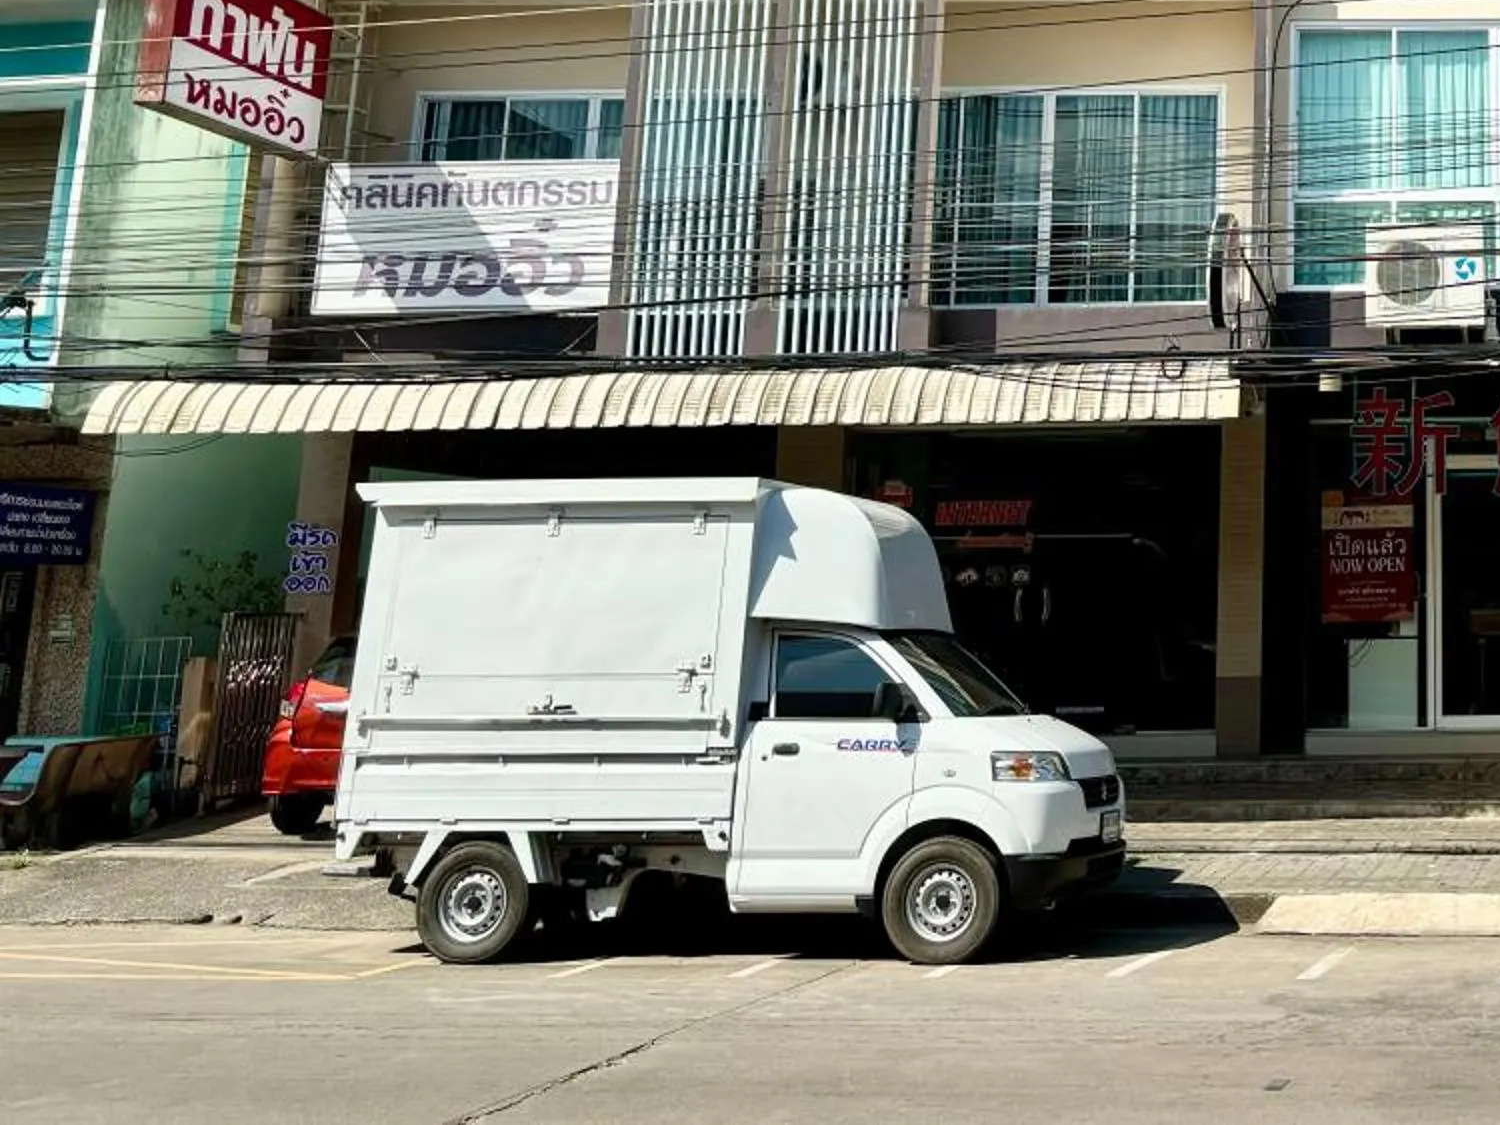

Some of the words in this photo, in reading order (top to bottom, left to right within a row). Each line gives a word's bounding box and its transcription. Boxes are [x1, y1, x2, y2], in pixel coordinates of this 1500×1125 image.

[184, 72, 306, 144] หมออิ๋ว
[1328, 530, 1407, 556] เปิดแล้ว
[1329, 558, 1365, 574] NOW
[1367, 556, 1406, 573] OPEN
[284, 575, 331, 593] ออก
[836, 738, 906, 752] CARRY
